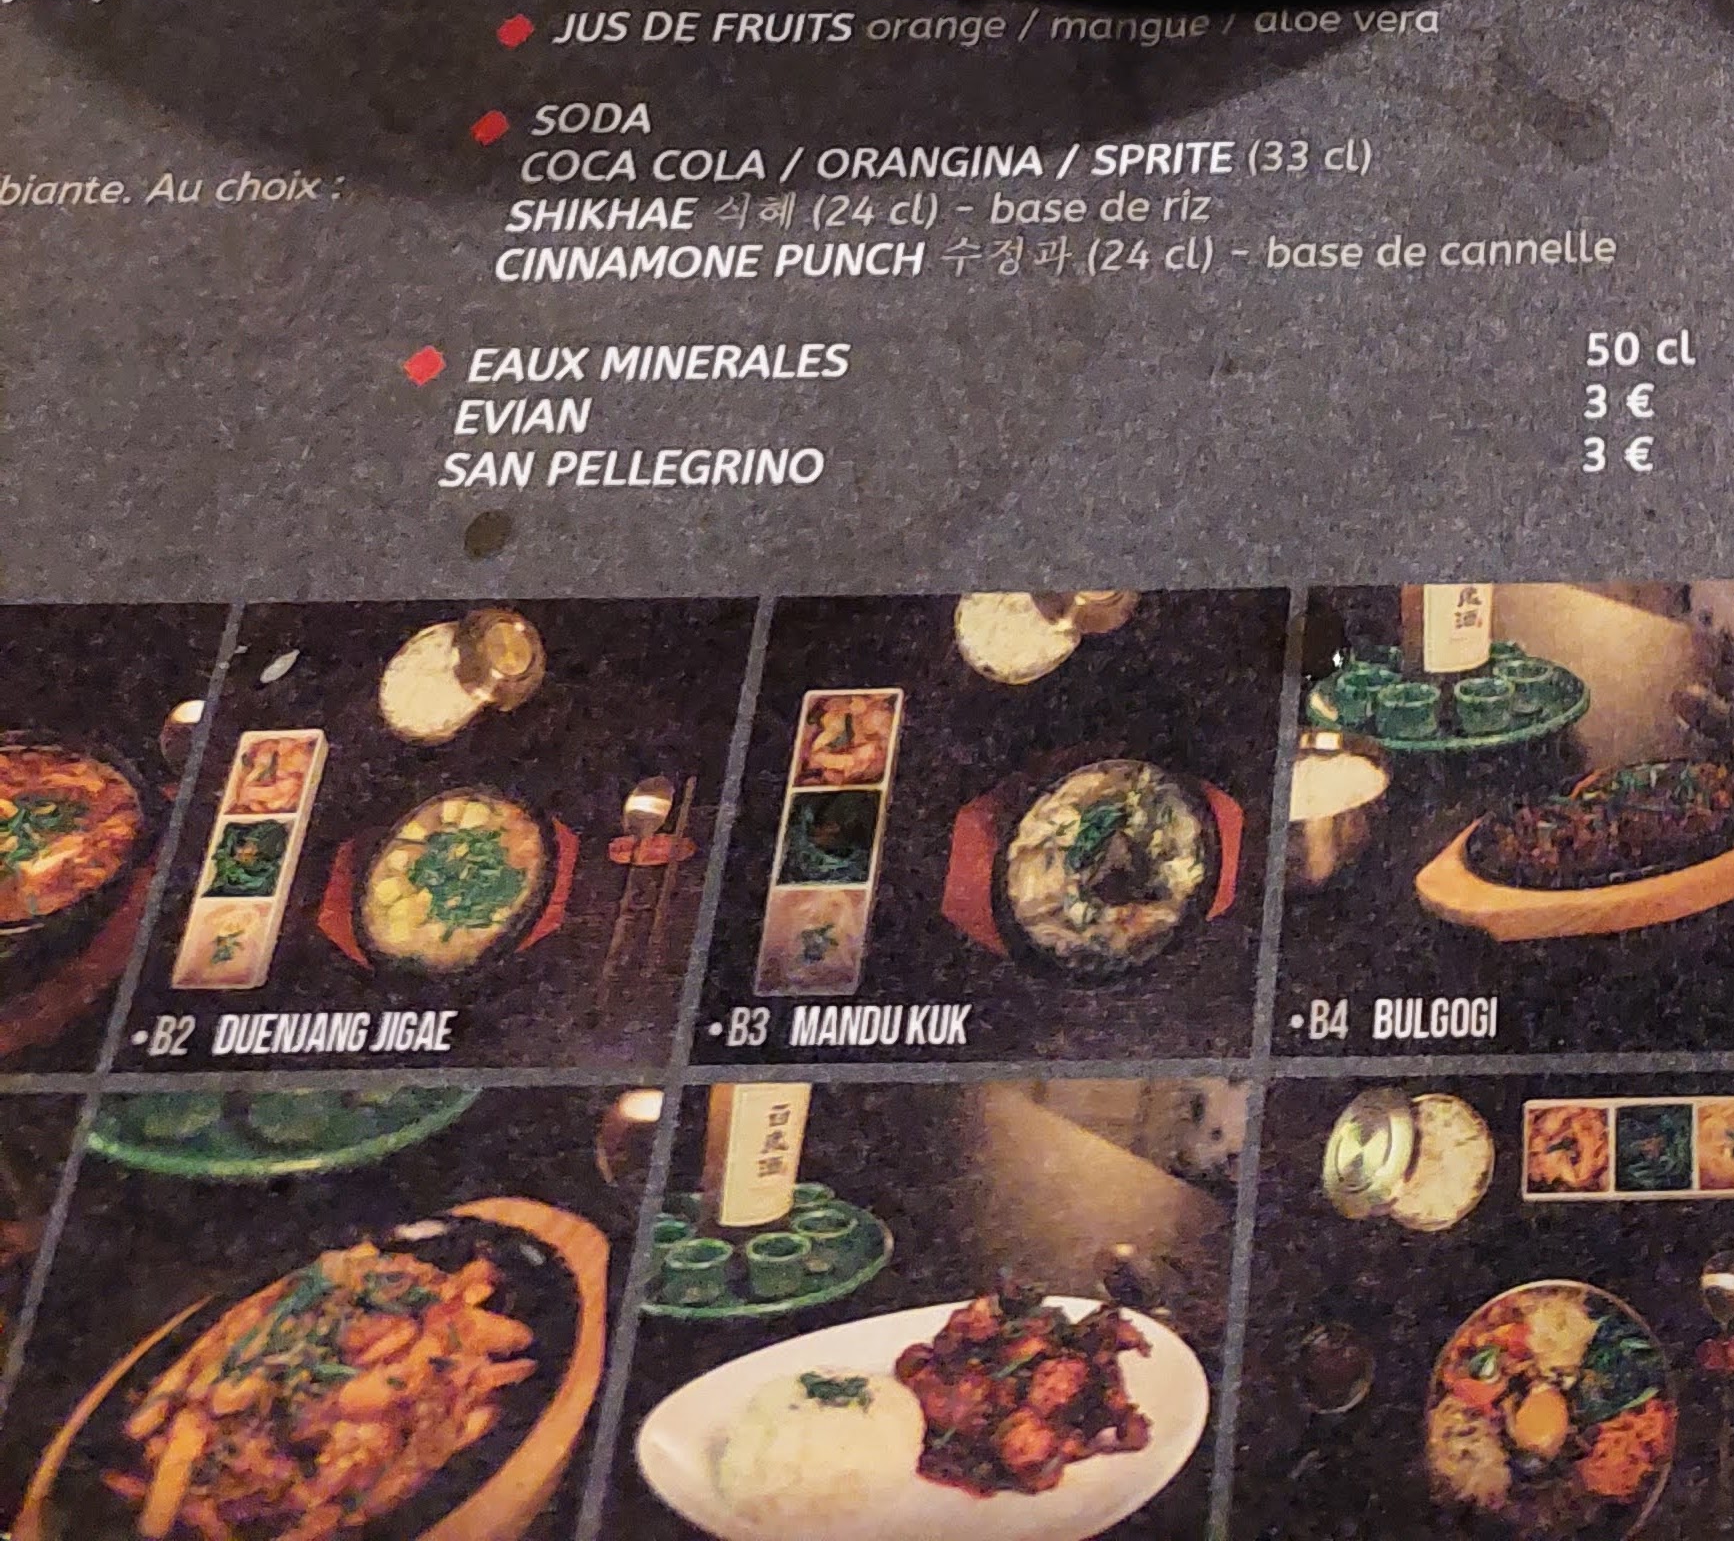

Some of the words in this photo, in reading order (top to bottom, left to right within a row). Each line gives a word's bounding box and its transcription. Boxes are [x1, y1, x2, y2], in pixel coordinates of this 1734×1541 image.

[552, 11, 632, 44] JUS
[642, 11, 701, 43] DE
[712, 12, 854, 43] FRUITS
[867, 16, 1006, 48] orange
[1050, 13, 1209, 48] mangue
[1254, 9, 1341, 33] aloe
[1356, 9, 1440, 34] vera
[530, 103, 652, 137] SODA
[520, 148, 637, 182] COCA
[652, 148, 766, 181] COLA
[817, 143, 1044, 180] ORANGINA
[1090, 142, 1235, 178] SPRITE
[1246, 139, 1311, 179] (33
[1323, 139, 1374, 178] cl)
[145, 171, 202, 204] Au
[214, 170, 321, 202] choix
[505, 197, 698, 234] SHIKHAE
[812, 193, 875, 231] (24
[889, 192, 938, 230] cl)
[991, 191, 1087, 224] base
[1100, 190, 1150, 223] de
[1163, 191, 1211, 222] riz
[495, 243, 763, 281] CINNAMONE
[774, 240, 925, 278] PUNCH
[1087, 238, 1149, 277] (24
[1164, 236, 1214, 275] cl)
[1266, 235, 1363, 270] base
[1376, 232, 1427, 269] de
[1440, 231, 1617, 268] cannelle
[467, 348, 589, 383] EAUX
[600, 344, 850, 381] MINERALES
[1586, 332, 1640, 366] 50
[1657, 330, 1696, 365] cl
[454, 398, 592, 435] EVIAN
[1583, 386, 1608, 420] 3
[1626, 384, 1656, 419] €
[438, 452, 532, 488] SAN
[546, 448, 826, 487] PELLEGRINO
[1582, 439, 1607, 473] 3
[1624, 436, 1655, 472] €
[149, 1015, 196, 1056] B2
[211, 1011, 371, 1056] DUENJANG
[369, 1010, 459, 1052] JIGAE
[725, 1007, 770, 1047] B3
[790, 1004, 905, 1046] MANDU
[906, 1004, 972, 1045] KUK
[1309, 998, 1349, 1039] B4
[1373, 997, 1499, 1040] BULGOGI
